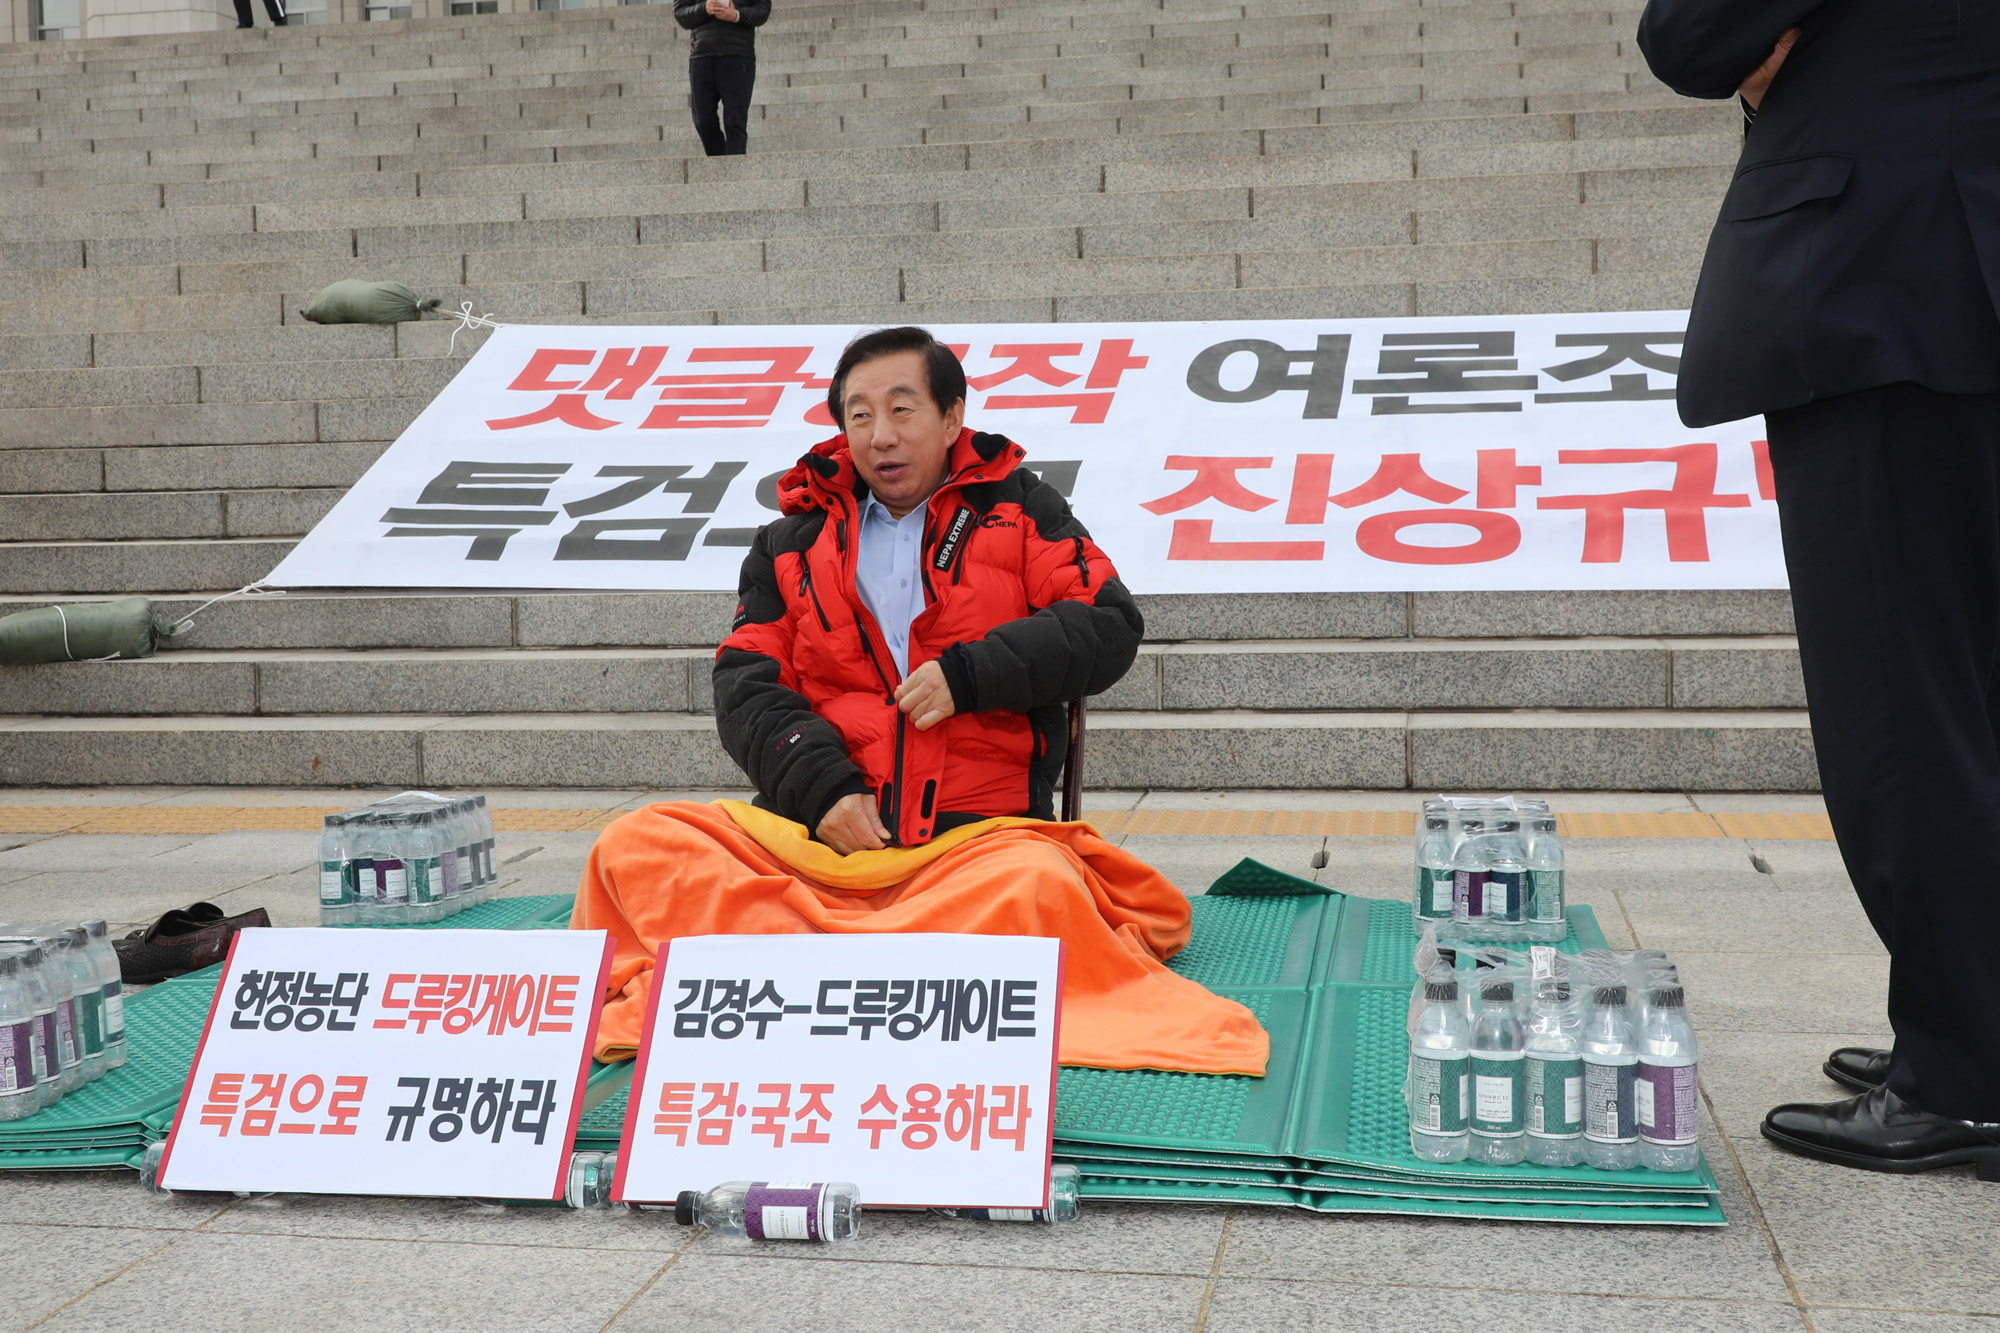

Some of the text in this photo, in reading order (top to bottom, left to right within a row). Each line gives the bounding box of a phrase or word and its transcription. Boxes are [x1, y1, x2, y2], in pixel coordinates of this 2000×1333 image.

[486, 338, 1150, 432] 댓글작
[379, 440, 1777, 565] 특검 진상규
[995, 521, 1018, 529] NEPA
[936, 543, 954, 568] NEPA
[948, 508, 970, 543] EXTREME
[230, 970, 580, 1037] 헌정농단 드루킹게이트
[199, 1073, 557, 1145] 특검으로 규명하라
[653, 1082, 1032, 1152] 특검·국조 수용하라
